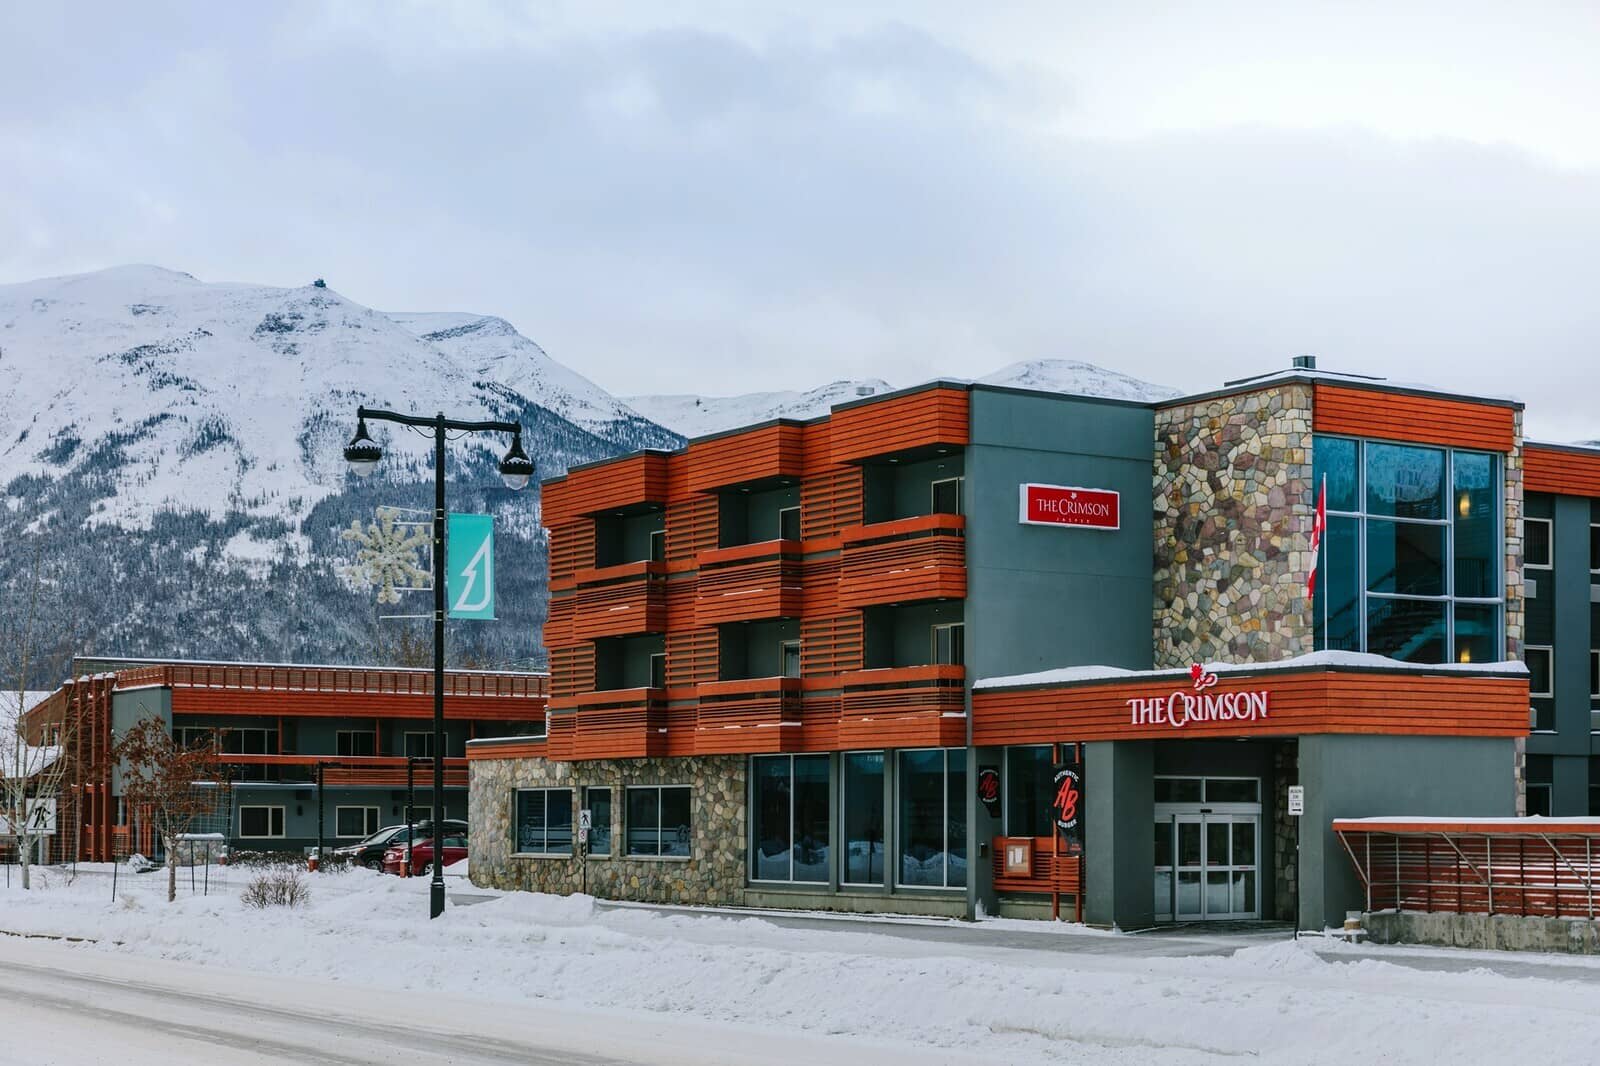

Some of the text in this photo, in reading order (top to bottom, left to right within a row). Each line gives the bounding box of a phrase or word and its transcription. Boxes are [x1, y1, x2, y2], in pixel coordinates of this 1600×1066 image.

[1036, 499, 1109, 516] THE CRIMSON
[1126, 691, 1268, 727] THE CRIMSON
[1053, 776, 1079, 821] AB
